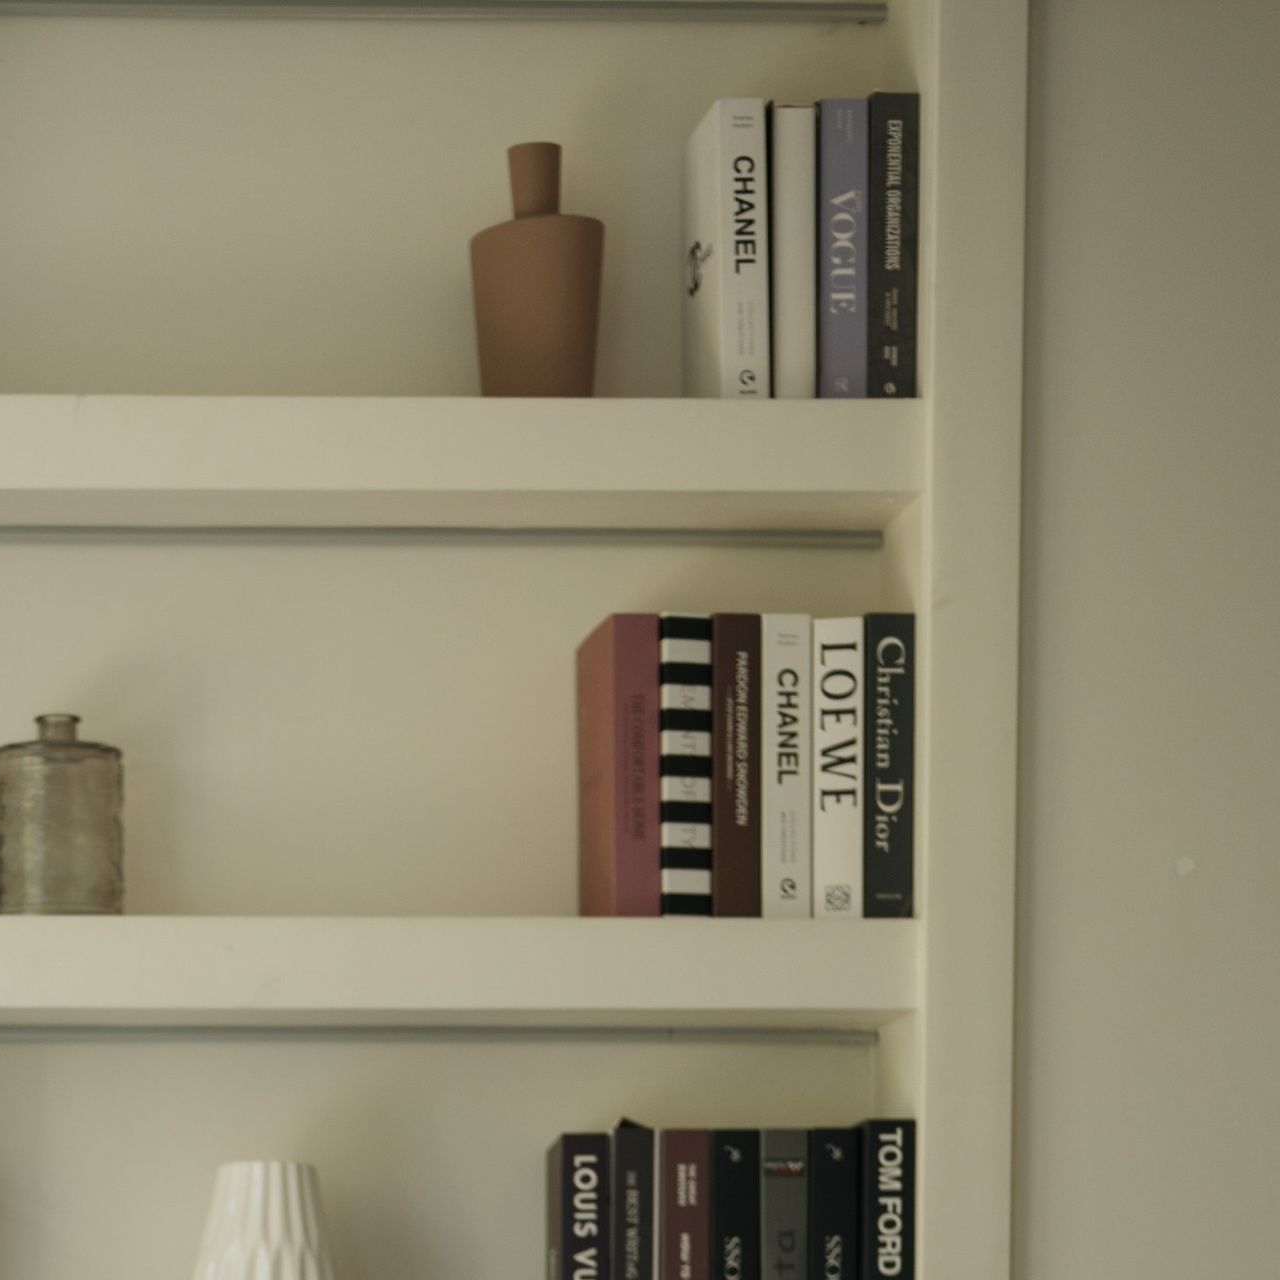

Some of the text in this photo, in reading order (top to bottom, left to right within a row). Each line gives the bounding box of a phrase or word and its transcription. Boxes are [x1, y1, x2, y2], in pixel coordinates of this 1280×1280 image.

[886, 120, 902, 187] EXPONENTIAL
[734, 156, 756, 273] CHANEL
[829, 190, 856, 314] VOGUE
[884, 190, 901, 271] ORGANIZATIONS
[735, 652, 748, 826] PARDON EDWARD SNOWDEN
[777, 668, 798, 784] CHANEL
[820, 642, 858, 812] LOEWE
[875, 636, 905, 853] Christian Dior
[573, 1154, 598, 1238] LOUIS
[626, 1189, 639, 1225] BEST
[878, 1128, 903, 1276] TOM FORD
